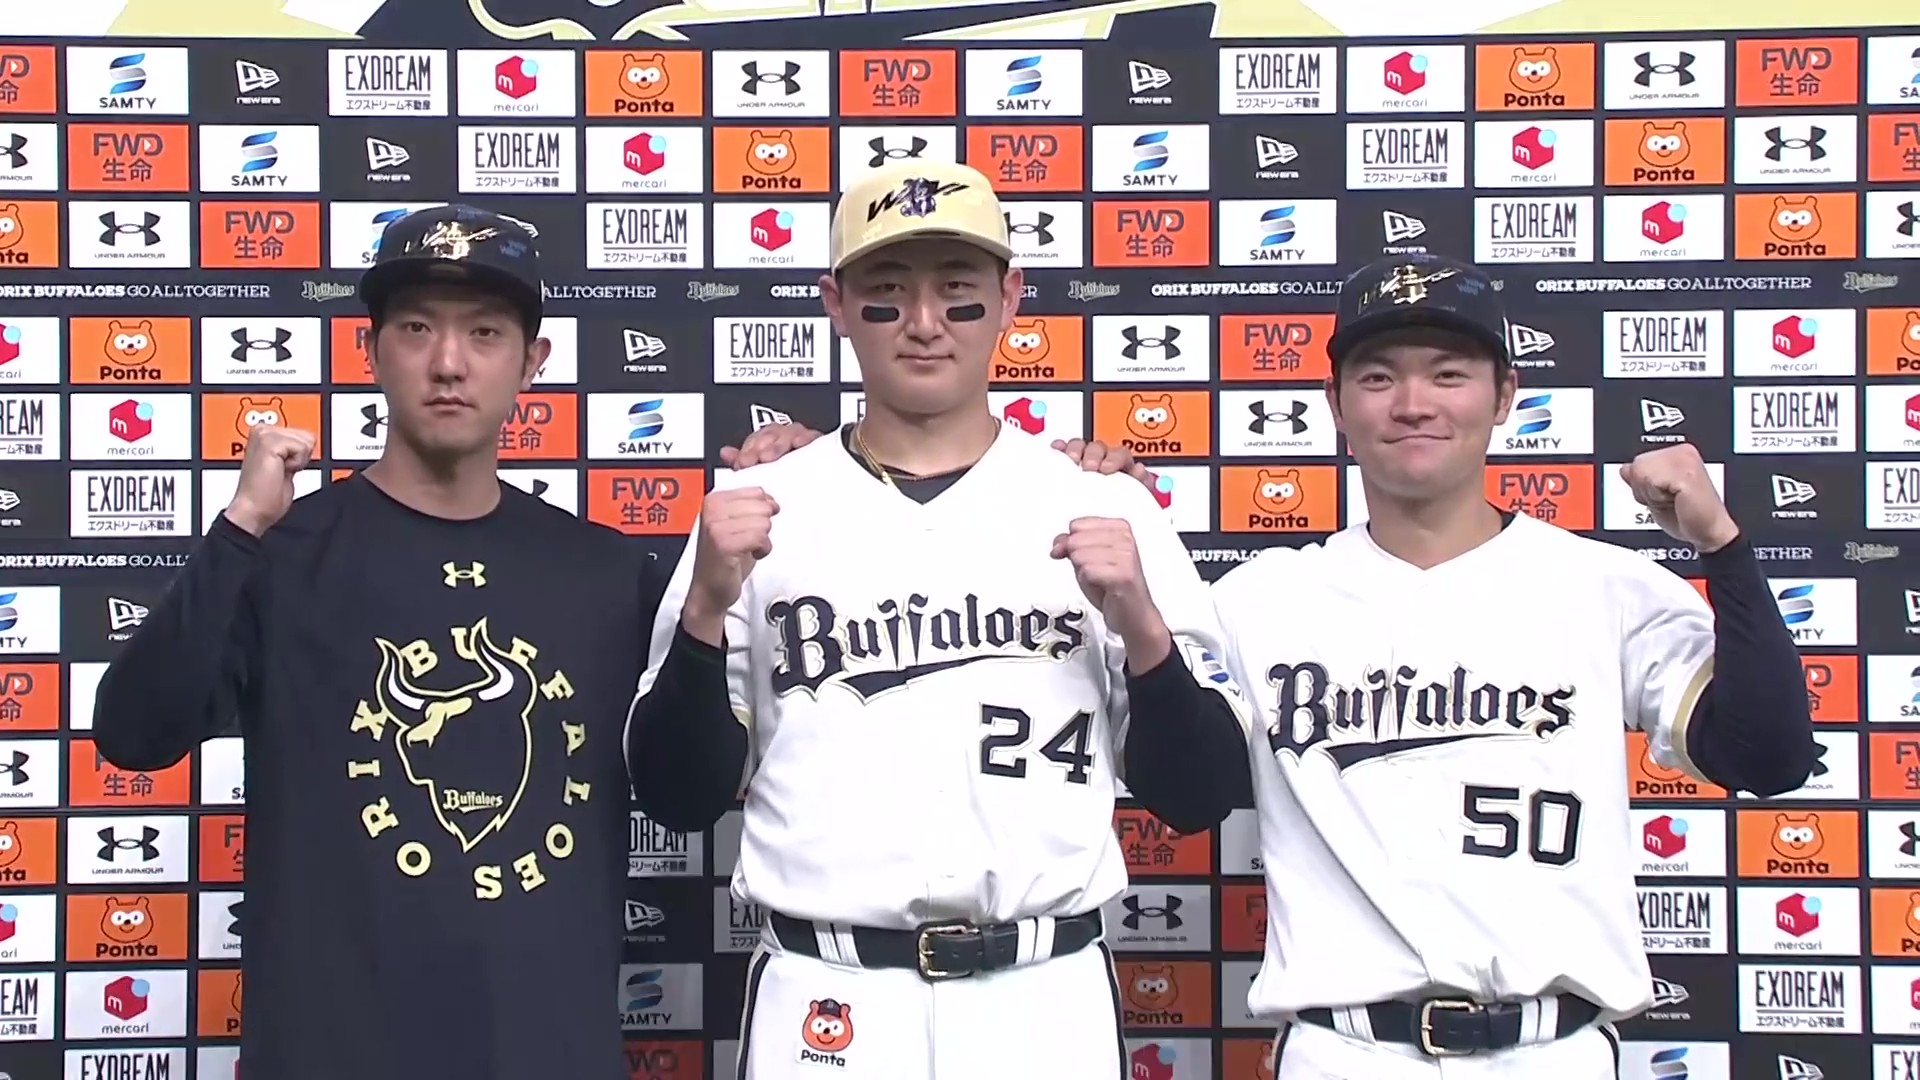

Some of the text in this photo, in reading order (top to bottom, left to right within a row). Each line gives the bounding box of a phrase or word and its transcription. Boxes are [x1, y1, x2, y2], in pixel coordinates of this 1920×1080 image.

[1762, 47, 1831, 72] FWD
[346, 55, 430, 91] EXDREAM
[864, 59, 931, 82] FWD
[1236, 54, 1320, 89] EXDREAM
[1770, 72, 1821, 96] 生命
[99, 96, 157, 109] SAMTY
[872, 84, 920, 108] 生命
[1381, 99, 1428, 108] mercari
[1504, 92, 1566, 109] Ponta
[1629, 92, 1700, 100] UNDER ARMOUR
[493, 103, 539, 113] mercari
[615, 99, 674, 113] Ponta
[736, 101, 806, 109] UNDER ARMOUR
[996, 99, 1052, 111] SAMTY
[94, 133, 163, 158] FWD
[475, 133, 559, 168] EXDREAM
[991, 134, 1057, 158] FWD
[1363, 129, 1447, 164] EXDREAM
[102, 158, 152, 182] 生命
[999, 159, 1047, 183] 生命
[1510, 173, 1557, 183] mercari
[1634, 167, 1694, 181] Ponta
[1759, 167, 1832, 175] UNDER ARMOUR
[231, 174, 288, 187] SAMTY
[621, 179, 667, 189] mercari
[742, 174, 801, 189] Ponta
[1123, 174, 1178, 187] SAMTY
[225, 211, 294, 235] FWD
[603, 209, 687, 244] EXDREAM
[1117, 209, 1184, 233] FWD
[1491, 203, 1576, 238] EXDREAM
[234, 235, 284, 260] 生命
[1126, 234, 1174, 258] 生命
[1249, 248, 1305, 261] SAMTY
[1639, 248, 1686, 257] mercari
[1765, 242, 1826, 256] Ponta
[748, 255, 794, 264] mercari
[34, 285, 125, 297] BUFFALOES
[771, 286, 808, 297] ORIX
[1152, 284, 1189, 296] ORIX
[1190, 283, 1279, 295] BUFFALOES
[1536, 280, 1573, 292] ORIX
[1573, 279, 1666, 291] BUFFALOES
[731, 323, 814, 358] EXDREAM
[1245, 323, 1312, 346] FWD
[1621, 317, 1706, 352] EXDREAM
[1253, 345, 1302, 372] 生命
[100, 366, 161, 380] Ponta
[995, 364, 1054, 378] Ponta
[1770, 363, 1818, 372] mercari
[503, 402, 552, 424] WD
[1751, 392, 1838, 428] EXDREAM
[106, 446, 154, 456] mercari
[617, 441, 673, 454] SAMTY
[1505, 437, 1562, 450] SAMTY
[88, 476, 174, 512] EXDREAM
[612, 477, 679, 501] FWD
[1500, 473, 1568, 498] FWD
[620, 502, 669, 526] 生命
[1249, 514, 1308, 528] Ponta
[33, 555, 127, 567] BUFFALOES
[1791, 629, 1824, 640] MTY
[766, 593, 1087, 697] Buffaloes
[1267, 661, 1577, 757] Buffaloes
[980, 702, 1096, 786] 24
[400, 627, 590, 899] BUFFALOES
[103, 771, 154, 797] 生命
[348, 700, 431, 877] ORIX
[1636, 779, 1697, 794] Ponta
[443, 789, 503, 812] Buffaloes
[629, 817, 688, 852] DREAM
[1461, 782, 1584, 870] 50
[1126, 843, 1176, 867] 生命
[91, 867, 165, 875] UNDER ARMOUR
[629, 861, 688, 872] ドリーム不動産
[1641, 861, 1689, 872] mercari
[1767, 860, 1829, 874] Ponta
[1638, 893, 1710, 928] XDREAM
[96, 942, 159, 959] Ponta
[1641, 937, 1711, 949] スドリーム不動産
[1774, 941, 1823, 951] mercari
[1756, 971, 1844, 1007] EXDREAM
[1124, 1009, 1183, 1024] Ponta
[101, 1022, 149, 1034] mercari
[82, 1052, 170, 1080] EXDREAM
[800, 1050, 847, 1067] Ponta
